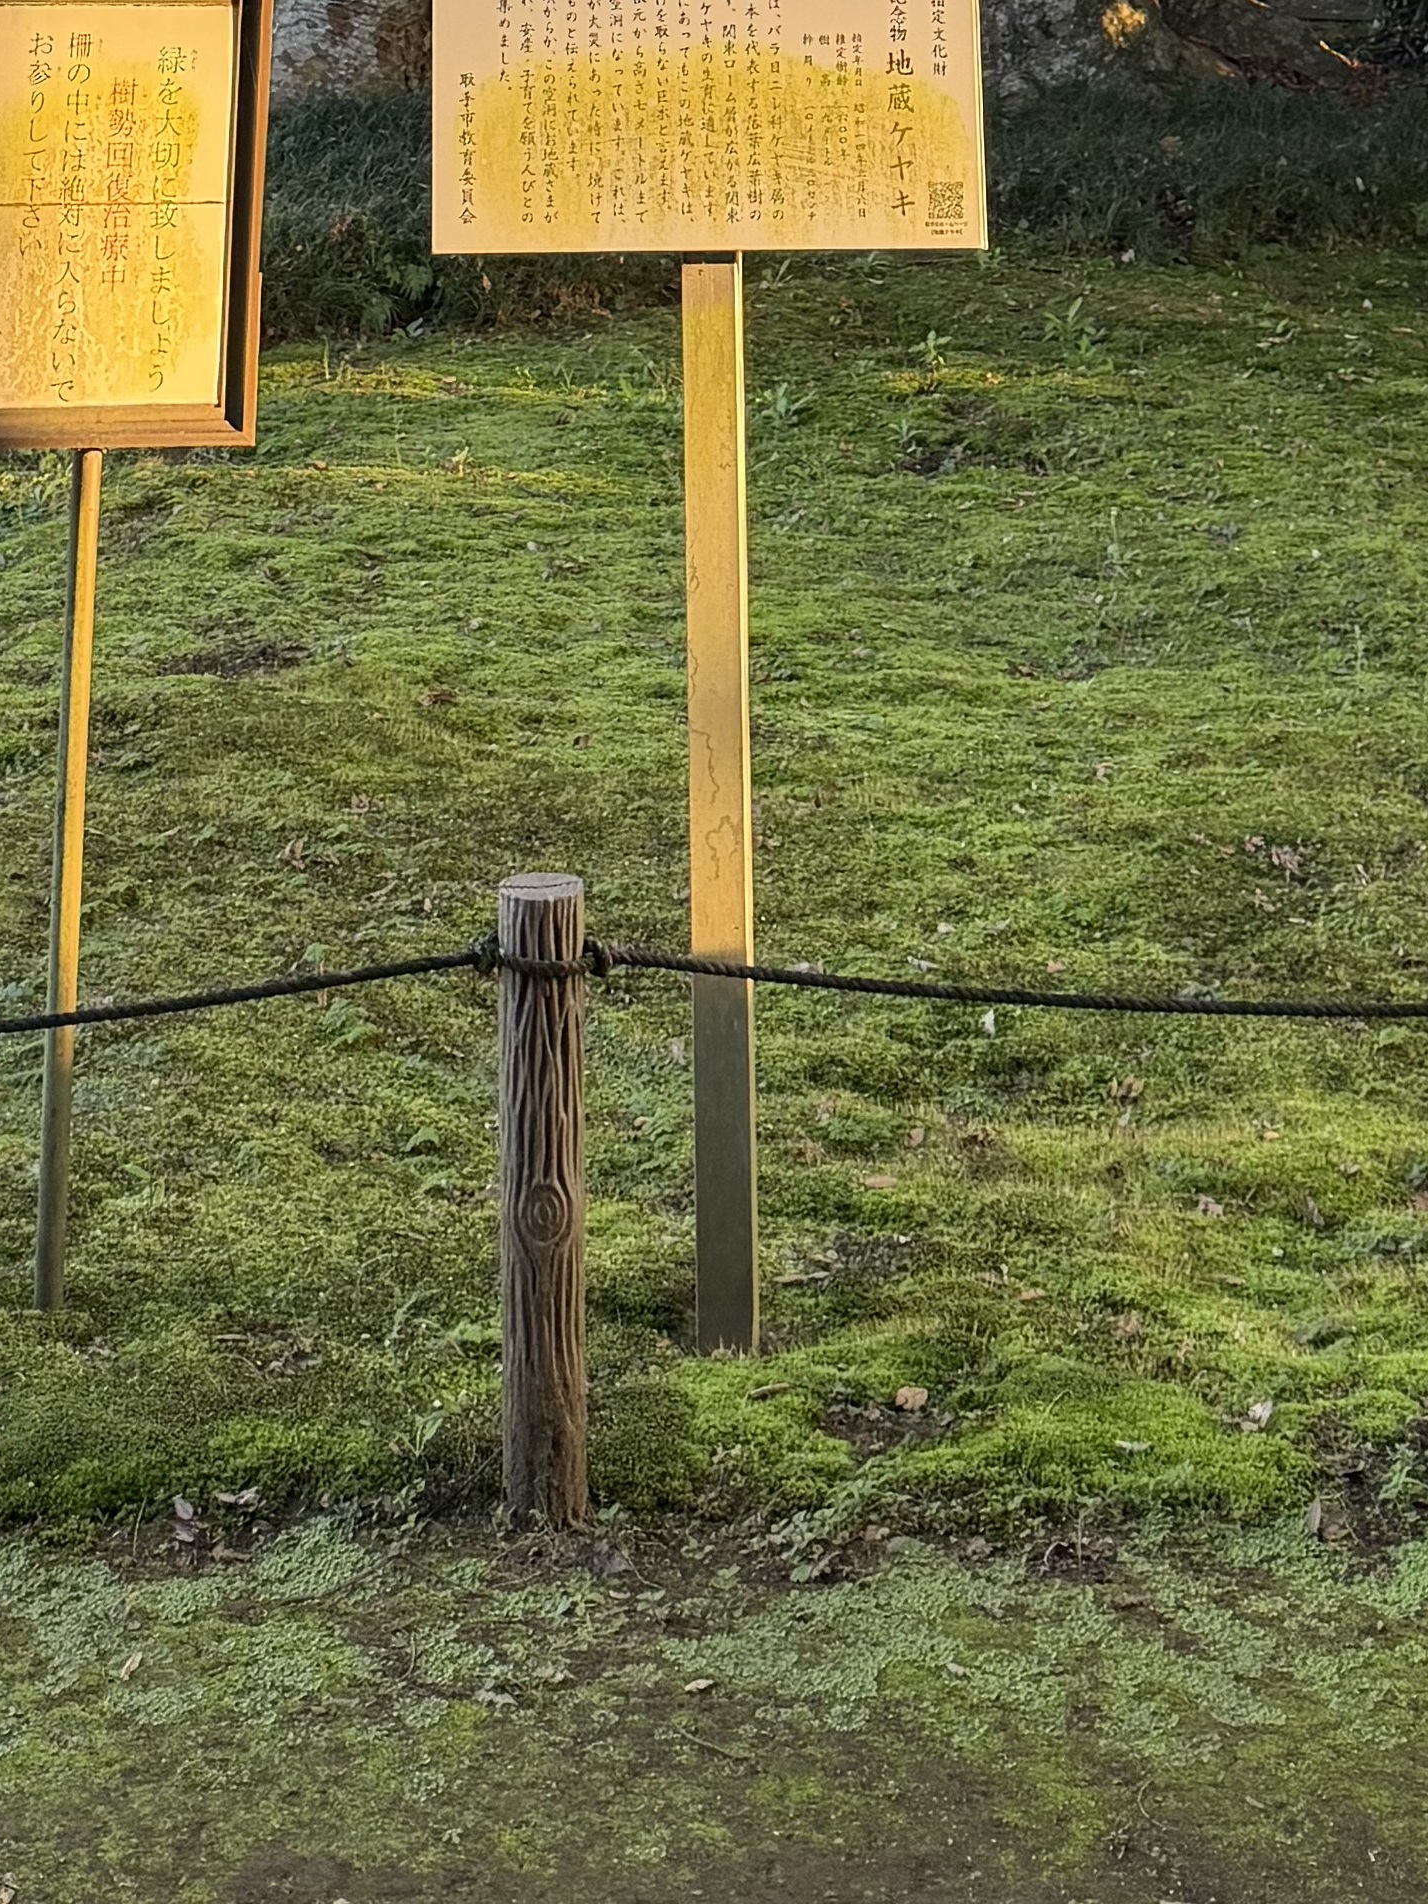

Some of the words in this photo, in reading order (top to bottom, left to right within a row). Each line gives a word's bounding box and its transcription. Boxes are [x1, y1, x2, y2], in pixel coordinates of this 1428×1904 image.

[18, 32, 54, 256] お参りして下さい
[50, 31, 93, 403] 柵の中には絶対に入らないで
[100, 76, 139, 293] 樹勢回復治療中
[147, 45, 187, 392] 緑を大切に致しましょう
[458, 72, 477, 225] 取手市教育委員会
[885, 48, 916, 217] 地蔵ケヤキ
